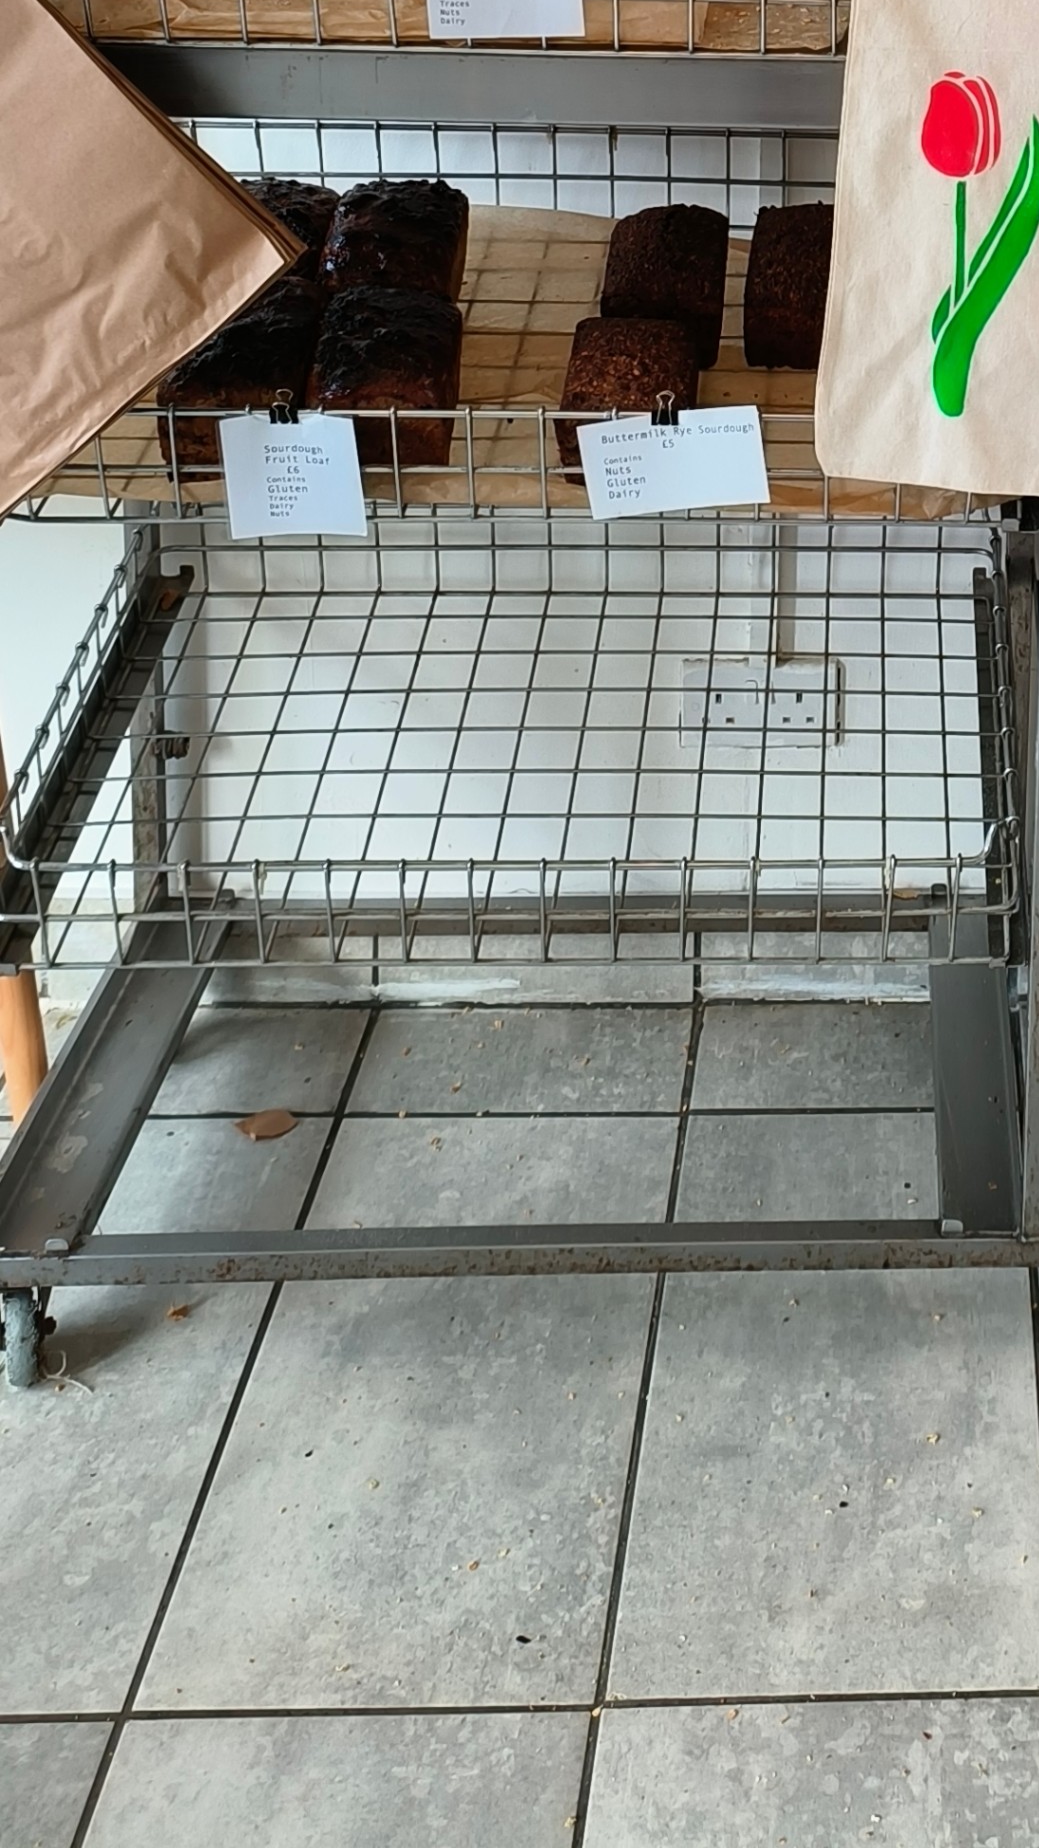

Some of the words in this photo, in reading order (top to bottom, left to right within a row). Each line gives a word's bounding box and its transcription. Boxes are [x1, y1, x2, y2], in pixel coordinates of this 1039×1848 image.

[601, 428, 666, 444] Buttermilk
[674, 427, 692, 436] Rye
[698, 423, 755, 434] Sourdough
[662, 440, 675, 448] £5
[264, 444, 323, 454] Sourdough
[265, 456, 299, 464] Fruit
[306, 456, 330, 465] Loaf
[604, 455, 642, 465] Contains
[287, 466, 300, 474] £6
[605, 467, 632, 476] Nuts
[607, 476, 646, 488] Gluten
[268, 485, 308, 493] Gluten
[609, 488, 641, 500] Dairy
